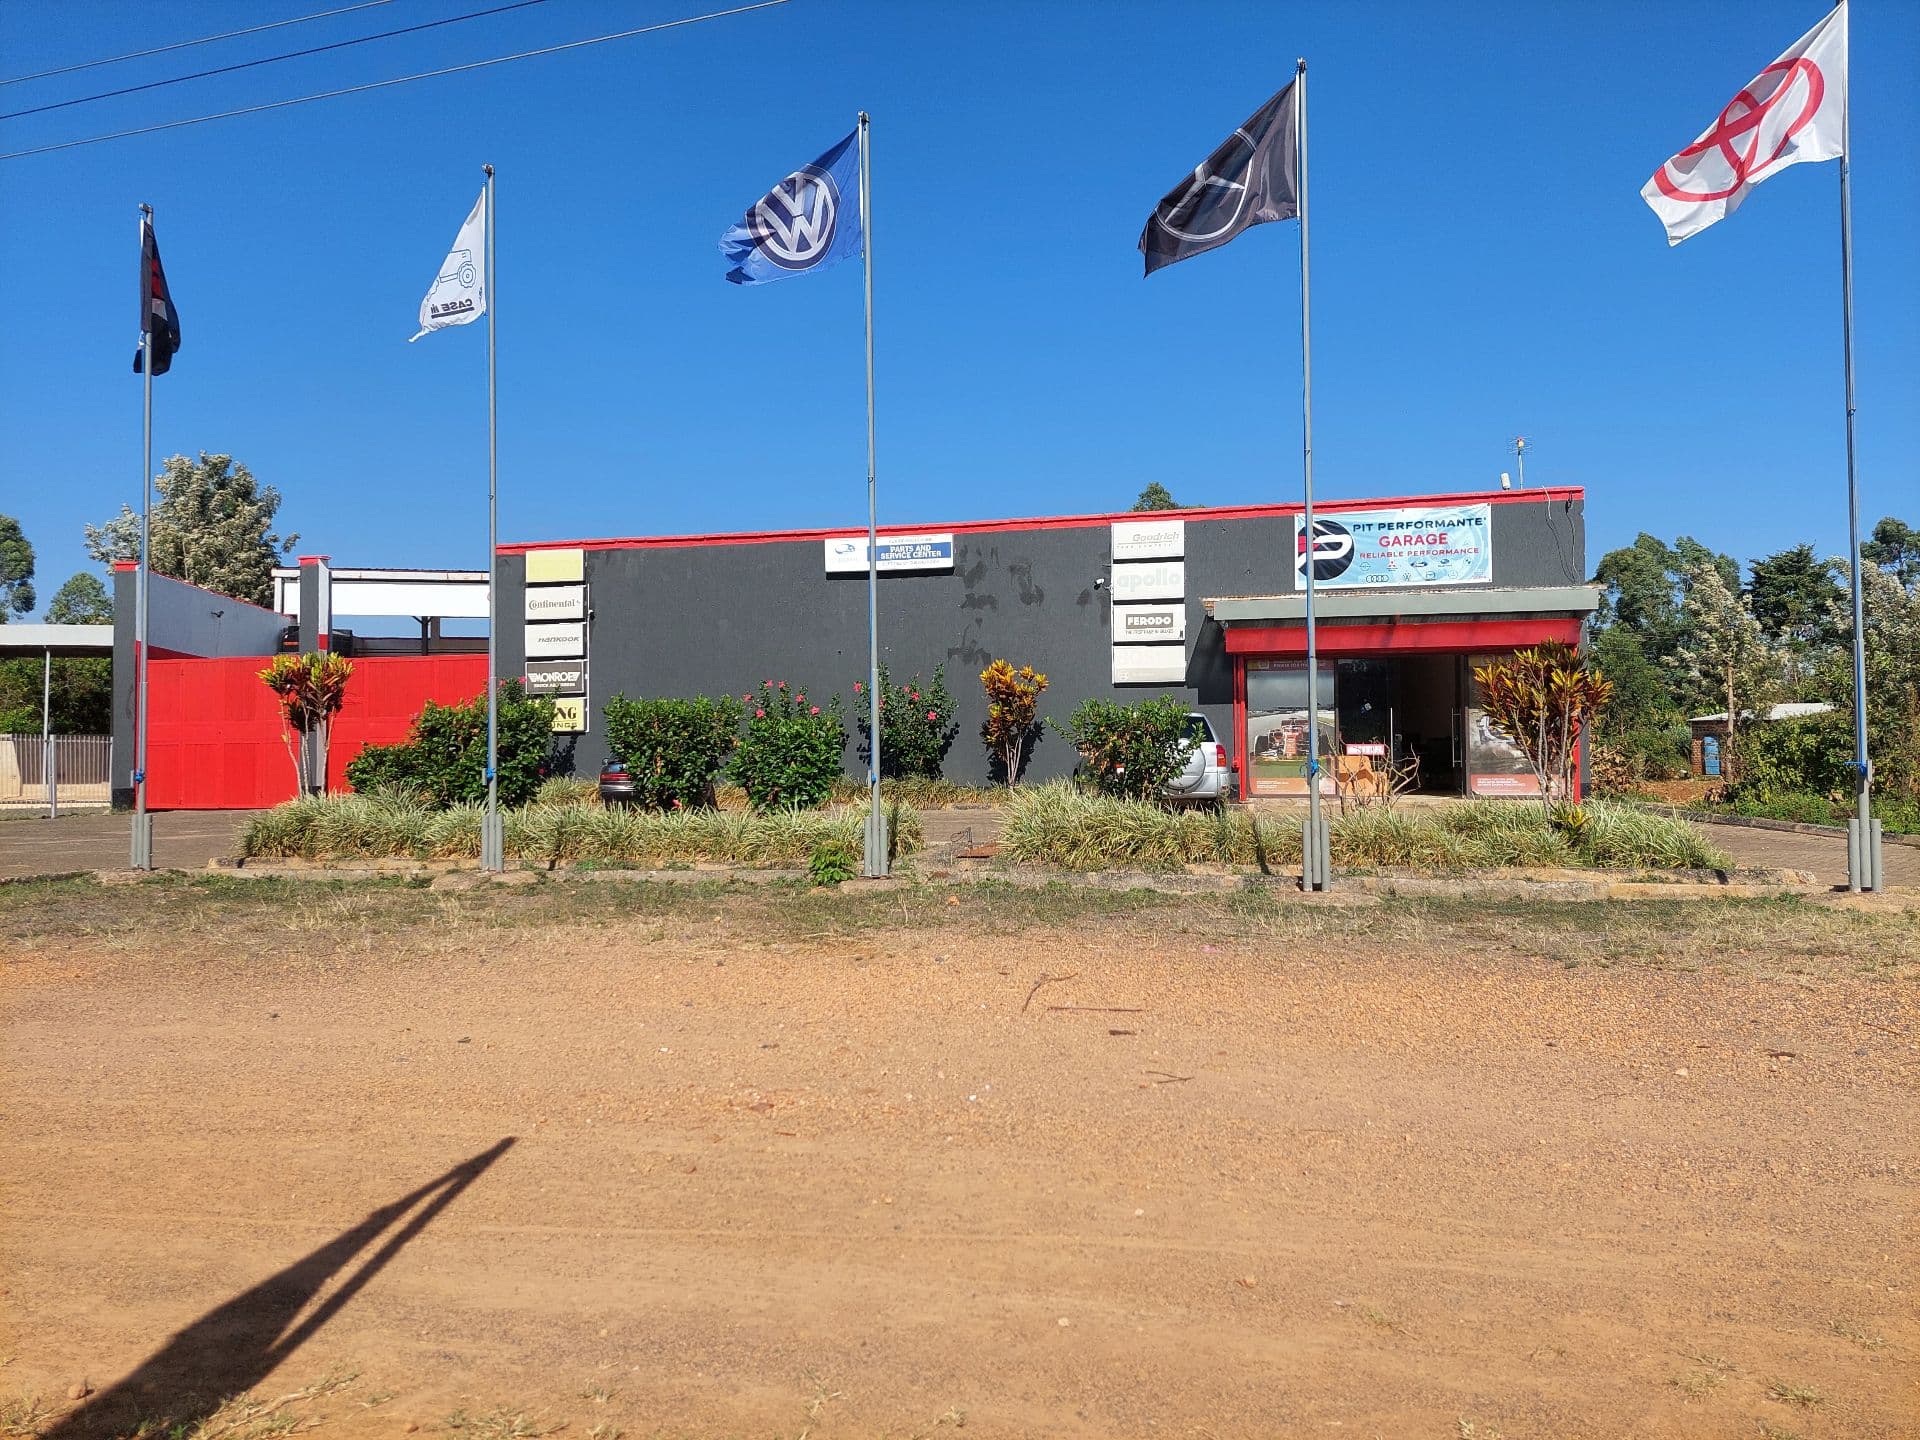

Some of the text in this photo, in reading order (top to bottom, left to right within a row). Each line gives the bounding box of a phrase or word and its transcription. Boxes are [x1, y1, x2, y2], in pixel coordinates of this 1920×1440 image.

[1353, 518, 1484, 532] PIT PERFORMANTE
[1132, 532, 1180, 542] Goodrich
[1379, 533, 1449, 548] GARAGE
[880, 550, 942, 560] SERVICE CENTER
[1360, 547, 1480, 559] RELIABLE PERFORMANCE
[1117, 568, 1181, 592] apollo
[528, 598, 575, 611] Continental
[1127, 616, 1172, 626] FERODO
